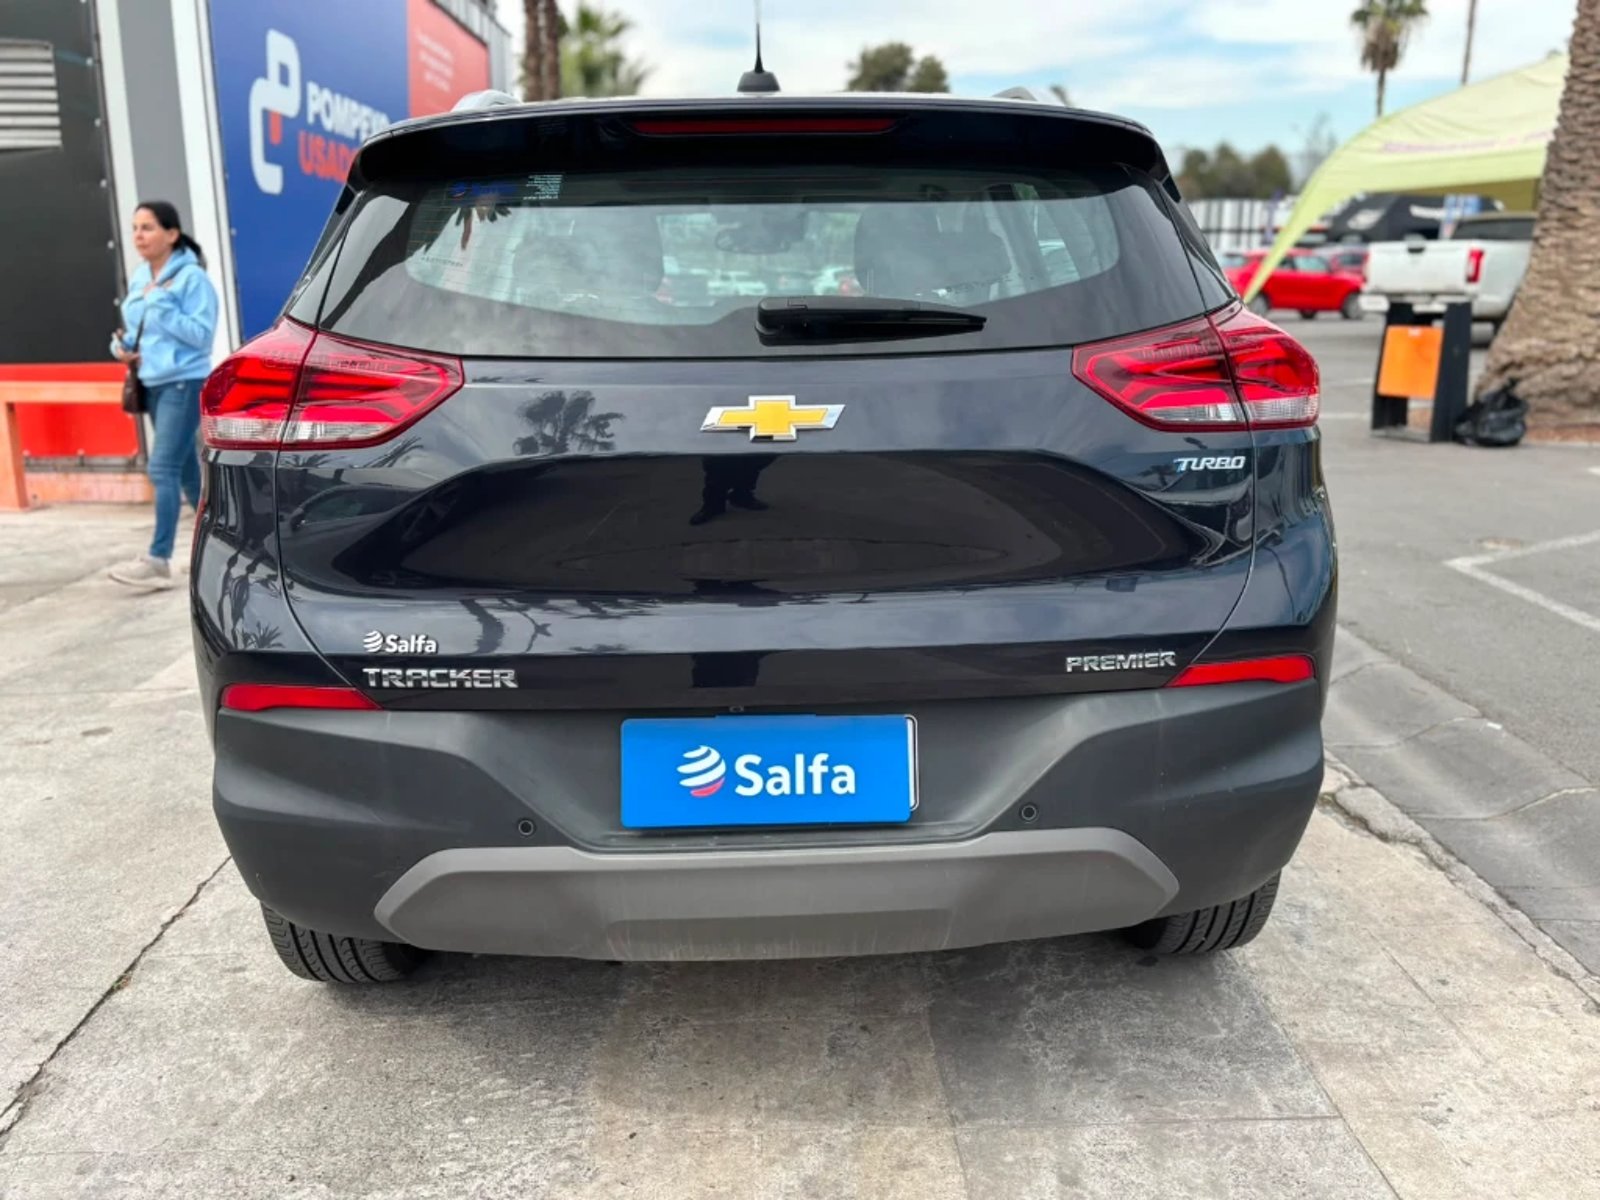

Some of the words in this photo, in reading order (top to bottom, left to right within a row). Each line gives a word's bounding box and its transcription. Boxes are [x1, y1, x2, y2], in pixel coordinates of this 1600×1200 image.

[298, 129, 358, 184] USAD
[1173, 456, 1246, 472] TURBO
[385, 634, 437, 653] Salfa
[1066, 651, 1176, 672] PREMIER
[362, 668, 518, 688] TRACKER
[734, 753, 856, 796] Salfa
